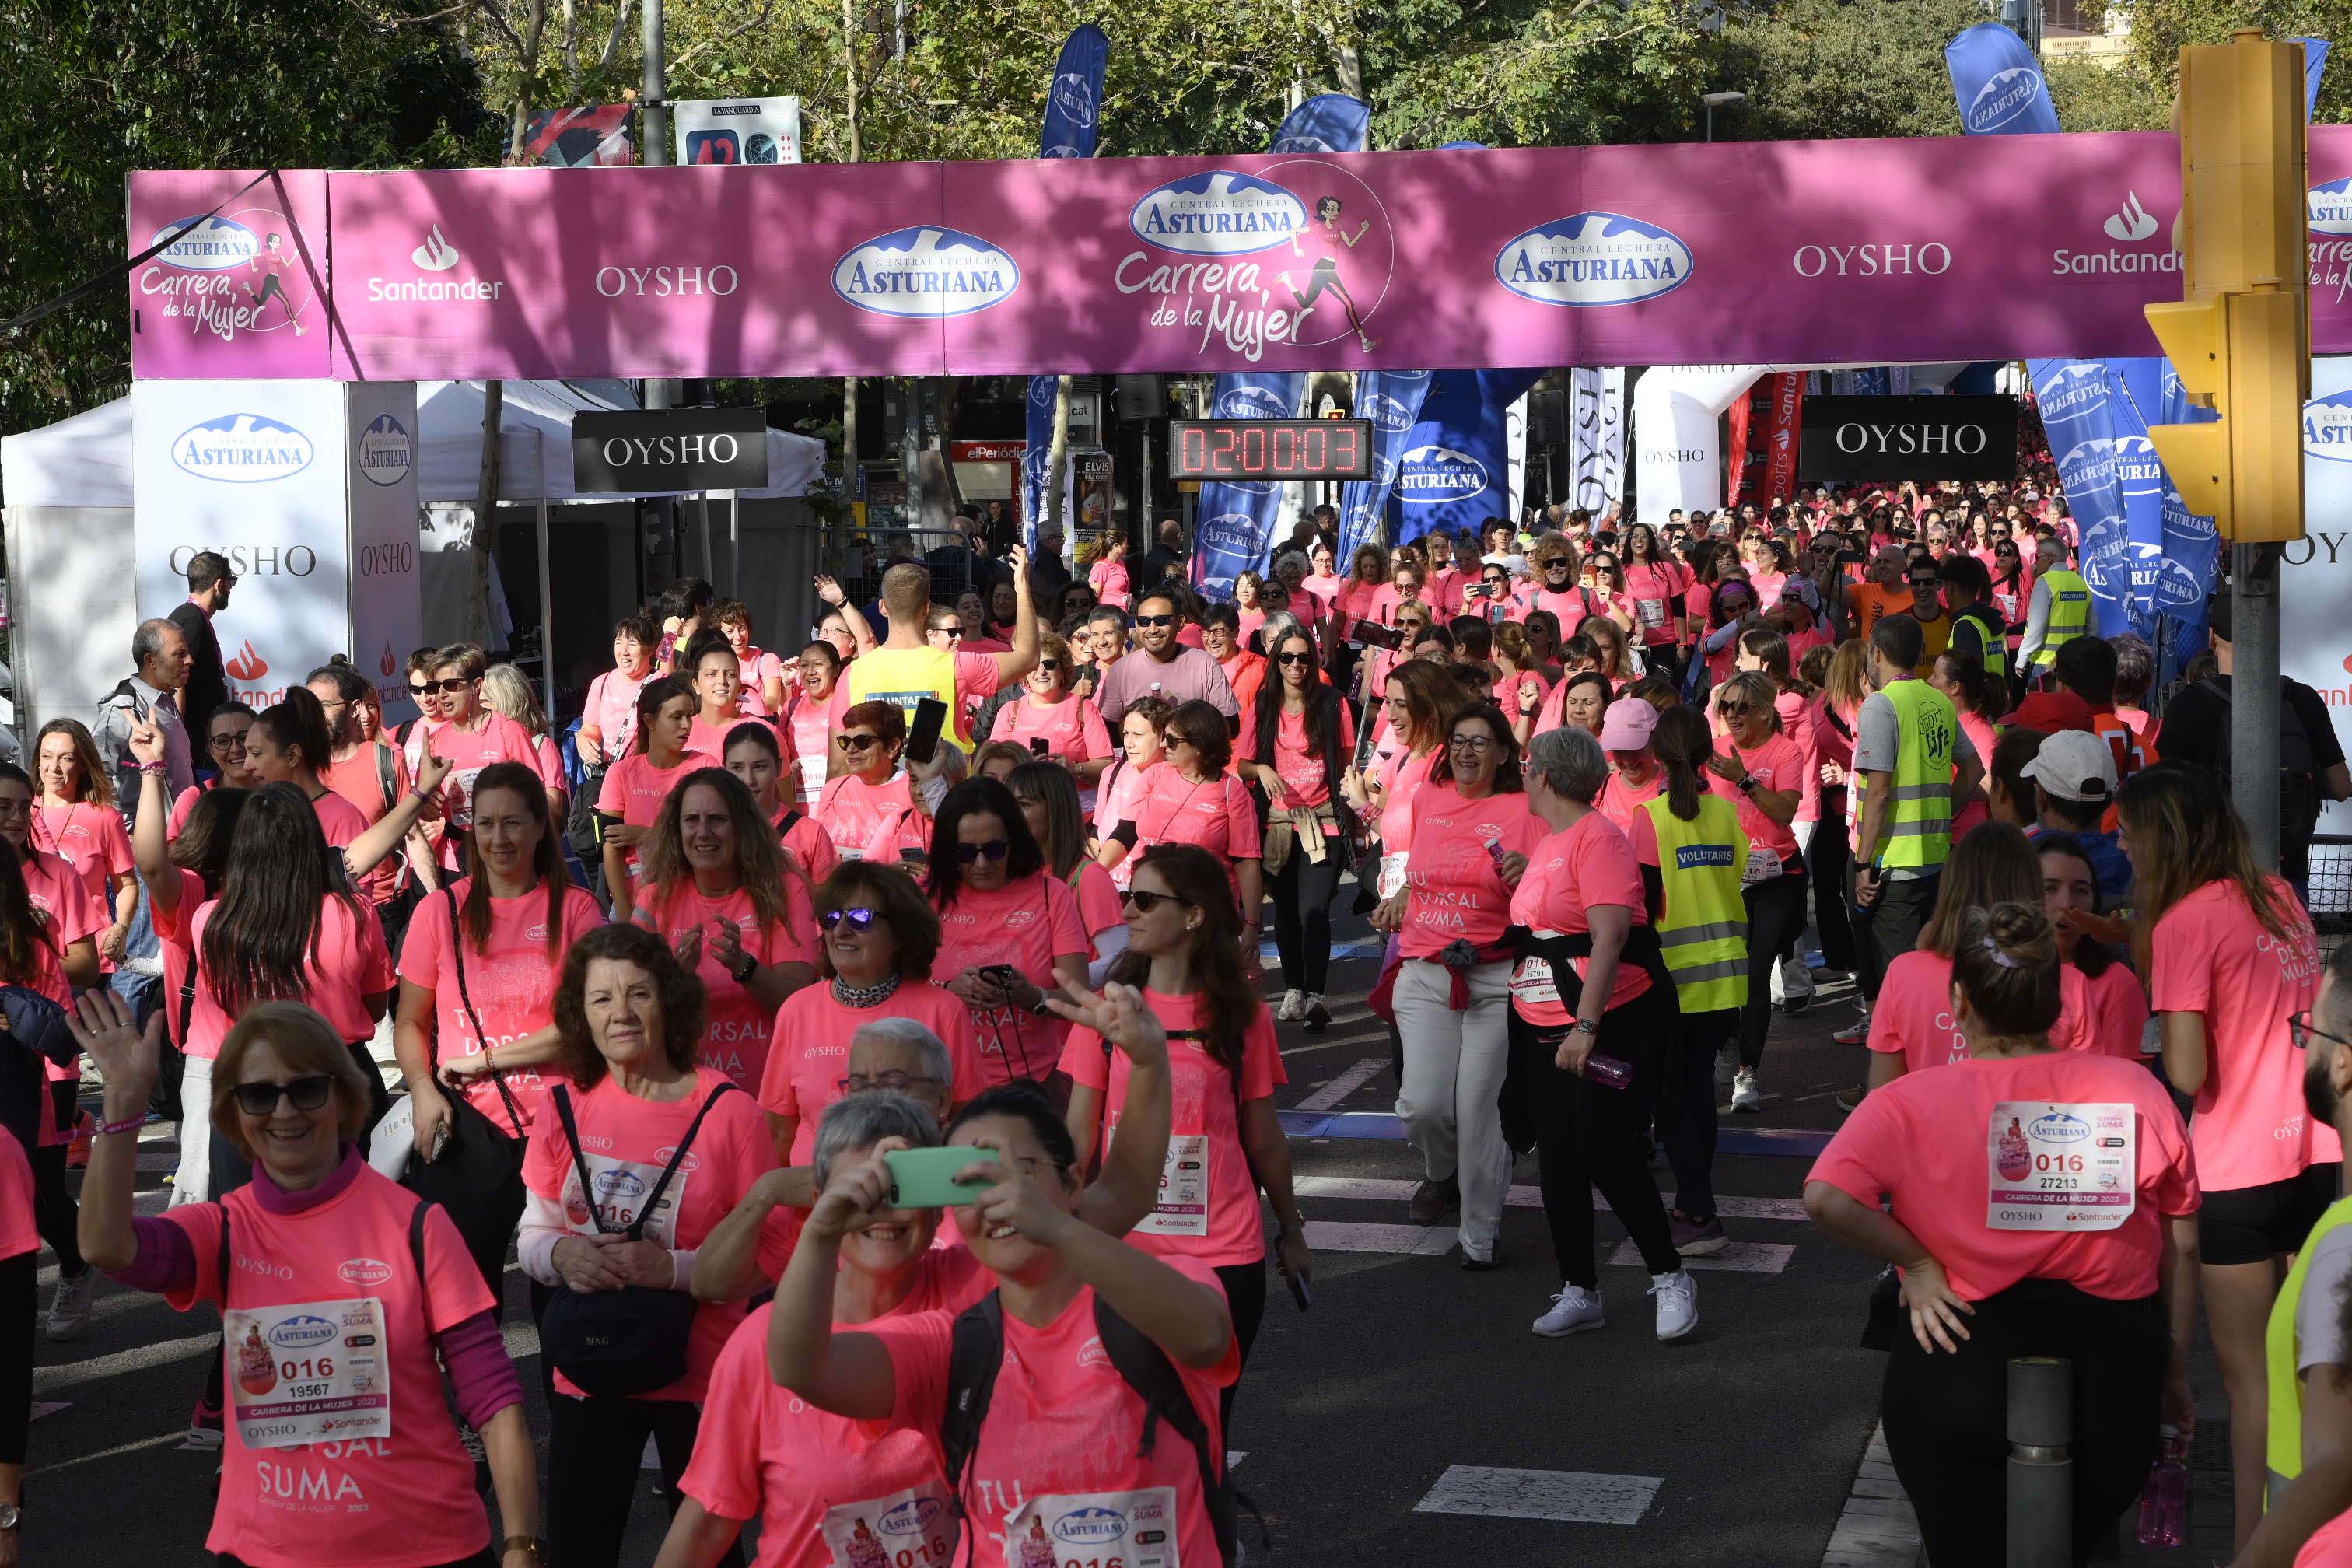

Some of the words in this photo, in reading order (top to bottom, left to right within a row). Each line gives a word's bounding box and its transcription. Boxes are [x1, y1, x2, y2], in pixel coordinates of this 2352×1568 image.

[1231, 198, 1288, 208] LECHERA
[1143, 204, 1293, 234] ASTURIANA
[1541, 245, 1601, 255] CENTRAL
[1608, 243, 1670, 254] LECHERA
[876, 257, 933, 267] CENTRAL
[940, 256, 998, 266] LECHERA
[1510, 249, 1677, 282] ASTURIANA
[1794, 243, 1951, 277] OYSHO
[140, 267, 231, 296] Carrera
[596, 265, 738, 296] OYSHO
[847, 261, 1005, 294] ASTURIANA
[1115, 251, 1260, 294] Carrera
[369, 278, 503, 302] Santander
[163, 298, 179, 317] de
[184, 297, 194, 317] la
[194, 292, 265, 341] Mujer
[1150, 296, 1178, 327] de
[1184, 296, 1202, 327] la
[1199, 289, 1314, 362] Mujer
[1779, 372, 1797, 425] Santa
[1836, 423, 1986, 453] OYSHO
[183, 440, 303, 465] ASTURIANA
[363, 444, 408, 468] ASTURIANA
[604, 434, 738, 466] OYSHO
[1182, 429, 1356, 471] 02:00:03
[1646, 449, 1704, 463] OYSHO
[1085, 462, 1109, 471] ELVIS
[1393, 474, 1481, 490] ASTURIANA
[1205, 525, 1263, 553] ASTURIANA
[361, 542, 411, 576] OYSHO
[1919, 707, 1944, 735] Sport
[1926, 724, 1949, 758] Life
[634, 789, 660, 797] OYSHO
[1426, 817, 1453, 828] OYSHO
[902, 834, 922, 843] OYSH
[1387, 877, 1400, 887] 016
[1416, 911, 1464, 926] SUMA
[2277, 944, 2298, 964] DE
[2301, 939, 2315, 956] LA
[1527, 958, 1549, 968] 016
[2281, 956, 2320, 983] MUJE
[971, 1010, 1027, 1026] RSAL
[702, 1021, 767, 1041] RSAL
[804, 1046, 845, 1059] OYSHO
[2033, 1125, 2086, 1136] ASTURIANA
[2036, 1154, 2084, 1172] 016
[597, 1177, 641, 1194] ASTURIANA
[2040, 1178, 2077, 1188] 27213
[1164, 1219, 1199, 1227] Santander
[2000, 1211, 2042, 1221] OYSHO
[2078, 1213, 2123, 1221] Santander
[236, 1254, 292, 1281] OYSHO
[342, 1266, 389, 1280] ASTURIANA
[342, 1318, 373, 1327] SUMA
[273, 1329, 333, 1342] ASTURIANA
[281, 1357, 334, 1380] 016
[289, 1384, 329, 1398] 19567
[250, 1405, 292, 1416] CARRERA
[295, 1404, 308, 1413] DE
[309, 1403, 320, 1412] LA
[322, 1401, 353, 1410] MUJER
[357, 1398, 376, 1407] 2023
[334, 1416, 382, 1427] Santander
[248, 1423, 296, 1439] OYSHO
[257, 1461, 363, 1500] SUMA
[346, 1503, 369, 1513] 2023
[1134, 1510, 1164, 1521] SUMA
[896, 1535, 946, 1568] 016
